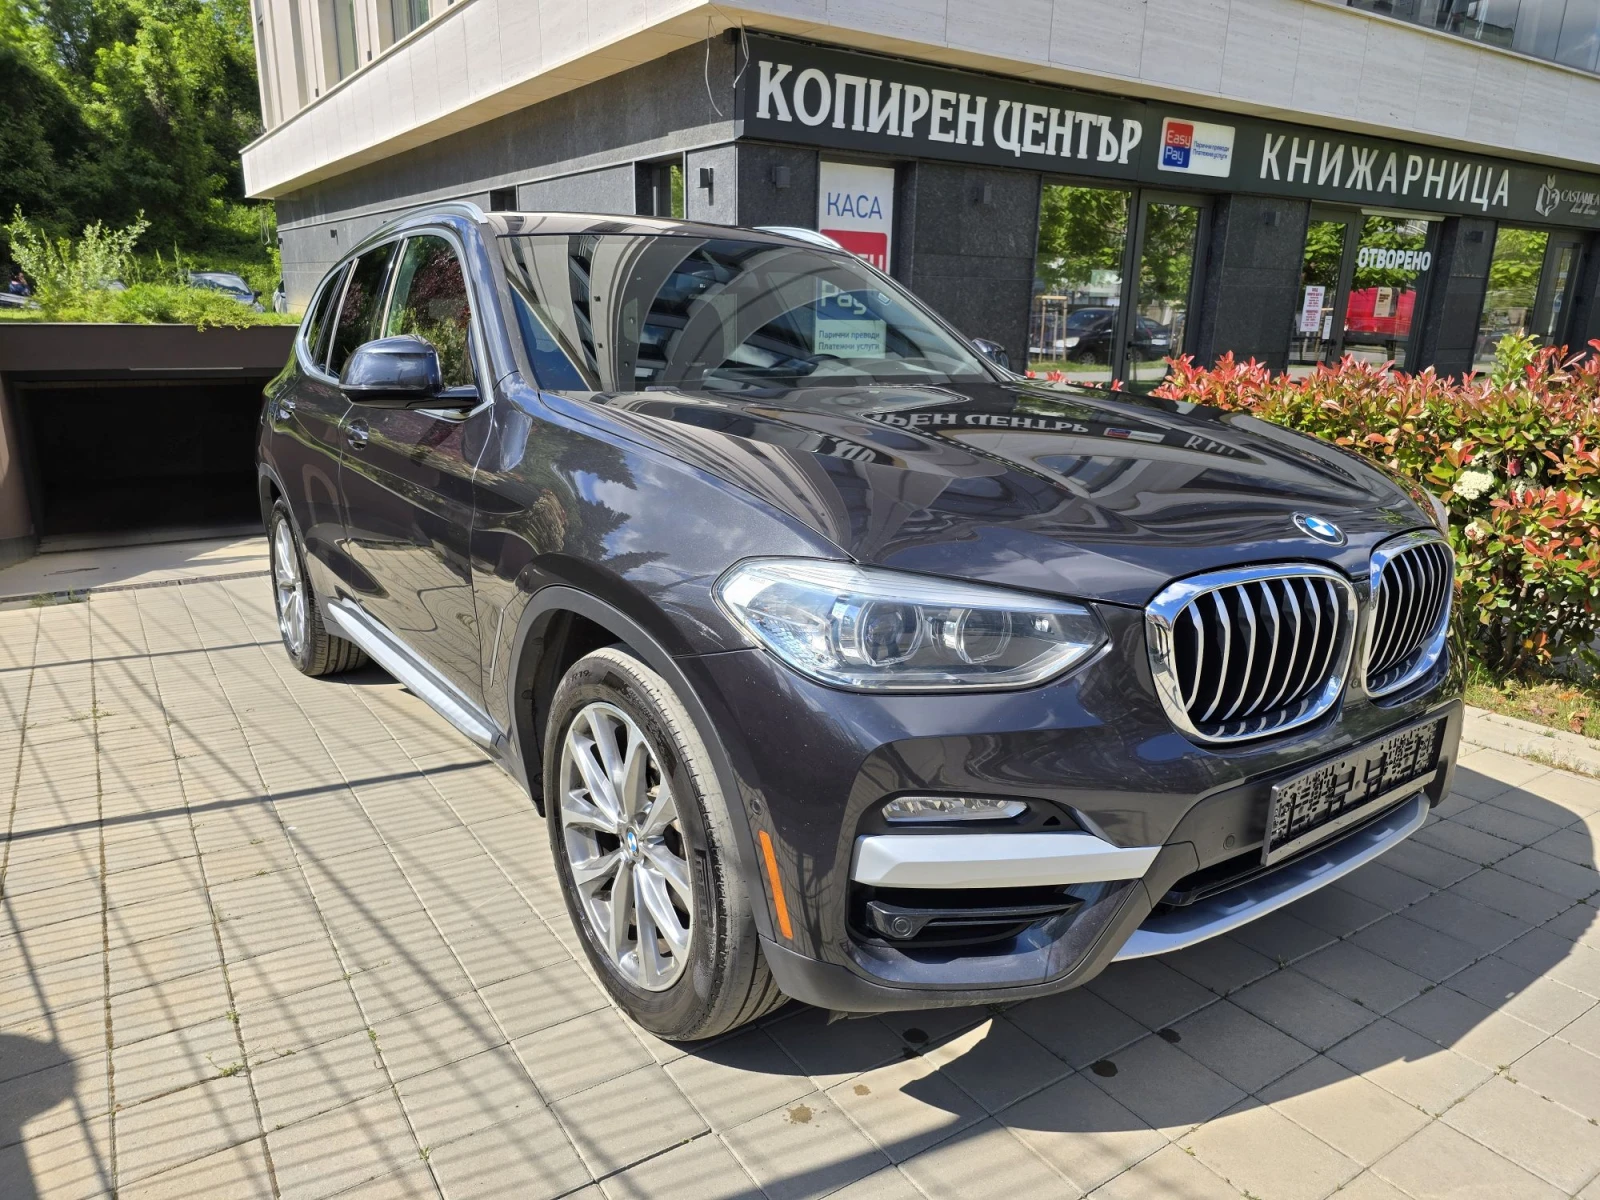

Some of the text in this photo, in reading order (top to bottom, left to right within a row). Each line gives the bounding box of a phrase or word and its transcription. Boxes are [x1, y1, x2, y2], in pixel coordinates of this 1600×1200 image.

[756, 60, 1142, 165] КОПИРЕН ЦЕНТЪР
[1167, 130, 1191, 148] Easy
[1165, 146, 1184, 164] Pay
[1259, 133, 1510, 211] КНИЖАРНИЦА
[827, 192, 883, 220] КАСА
[1358, 247, 1431, 271] ОТВОРЕНО
[819, 330, 880, 340] Парични преводи
[818, 342, 880, 351] Платежни услуги
